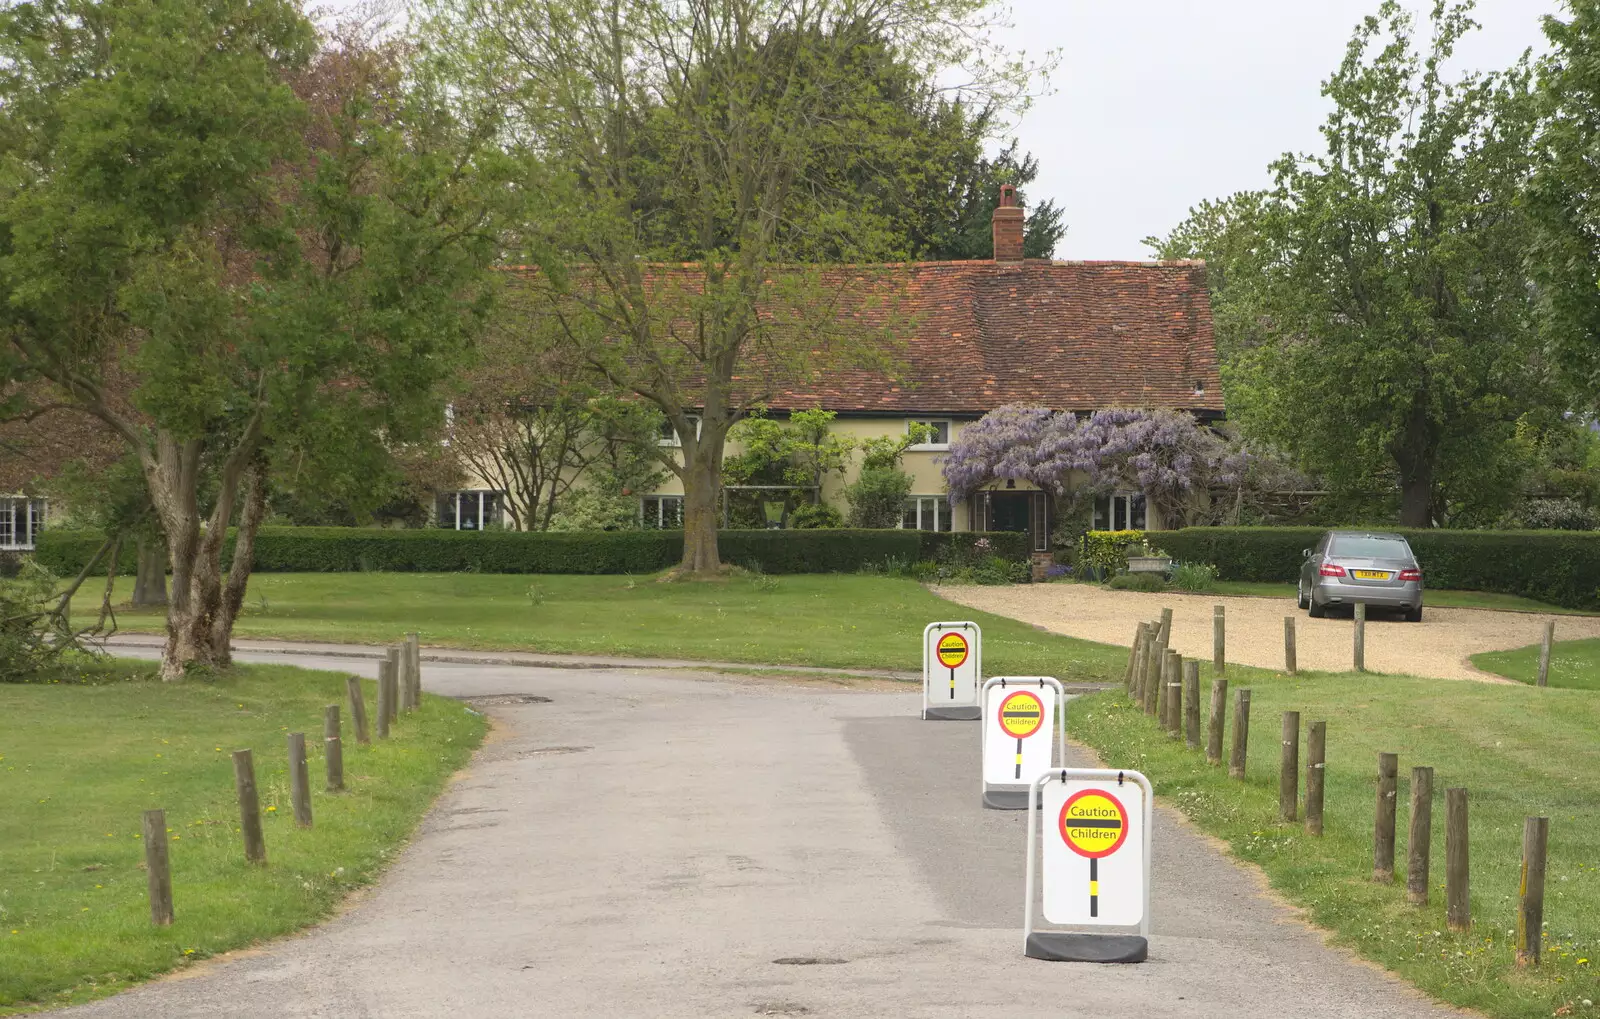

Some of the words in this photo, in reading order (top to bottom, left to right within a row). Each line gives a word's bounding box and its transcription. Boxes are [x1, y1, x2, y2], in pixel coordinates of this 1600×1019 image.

[1006, 702, 1038, 710] Caution
[1070, 805, 1117, 817] Caution
[1070, 828, 1117, 839] Children
